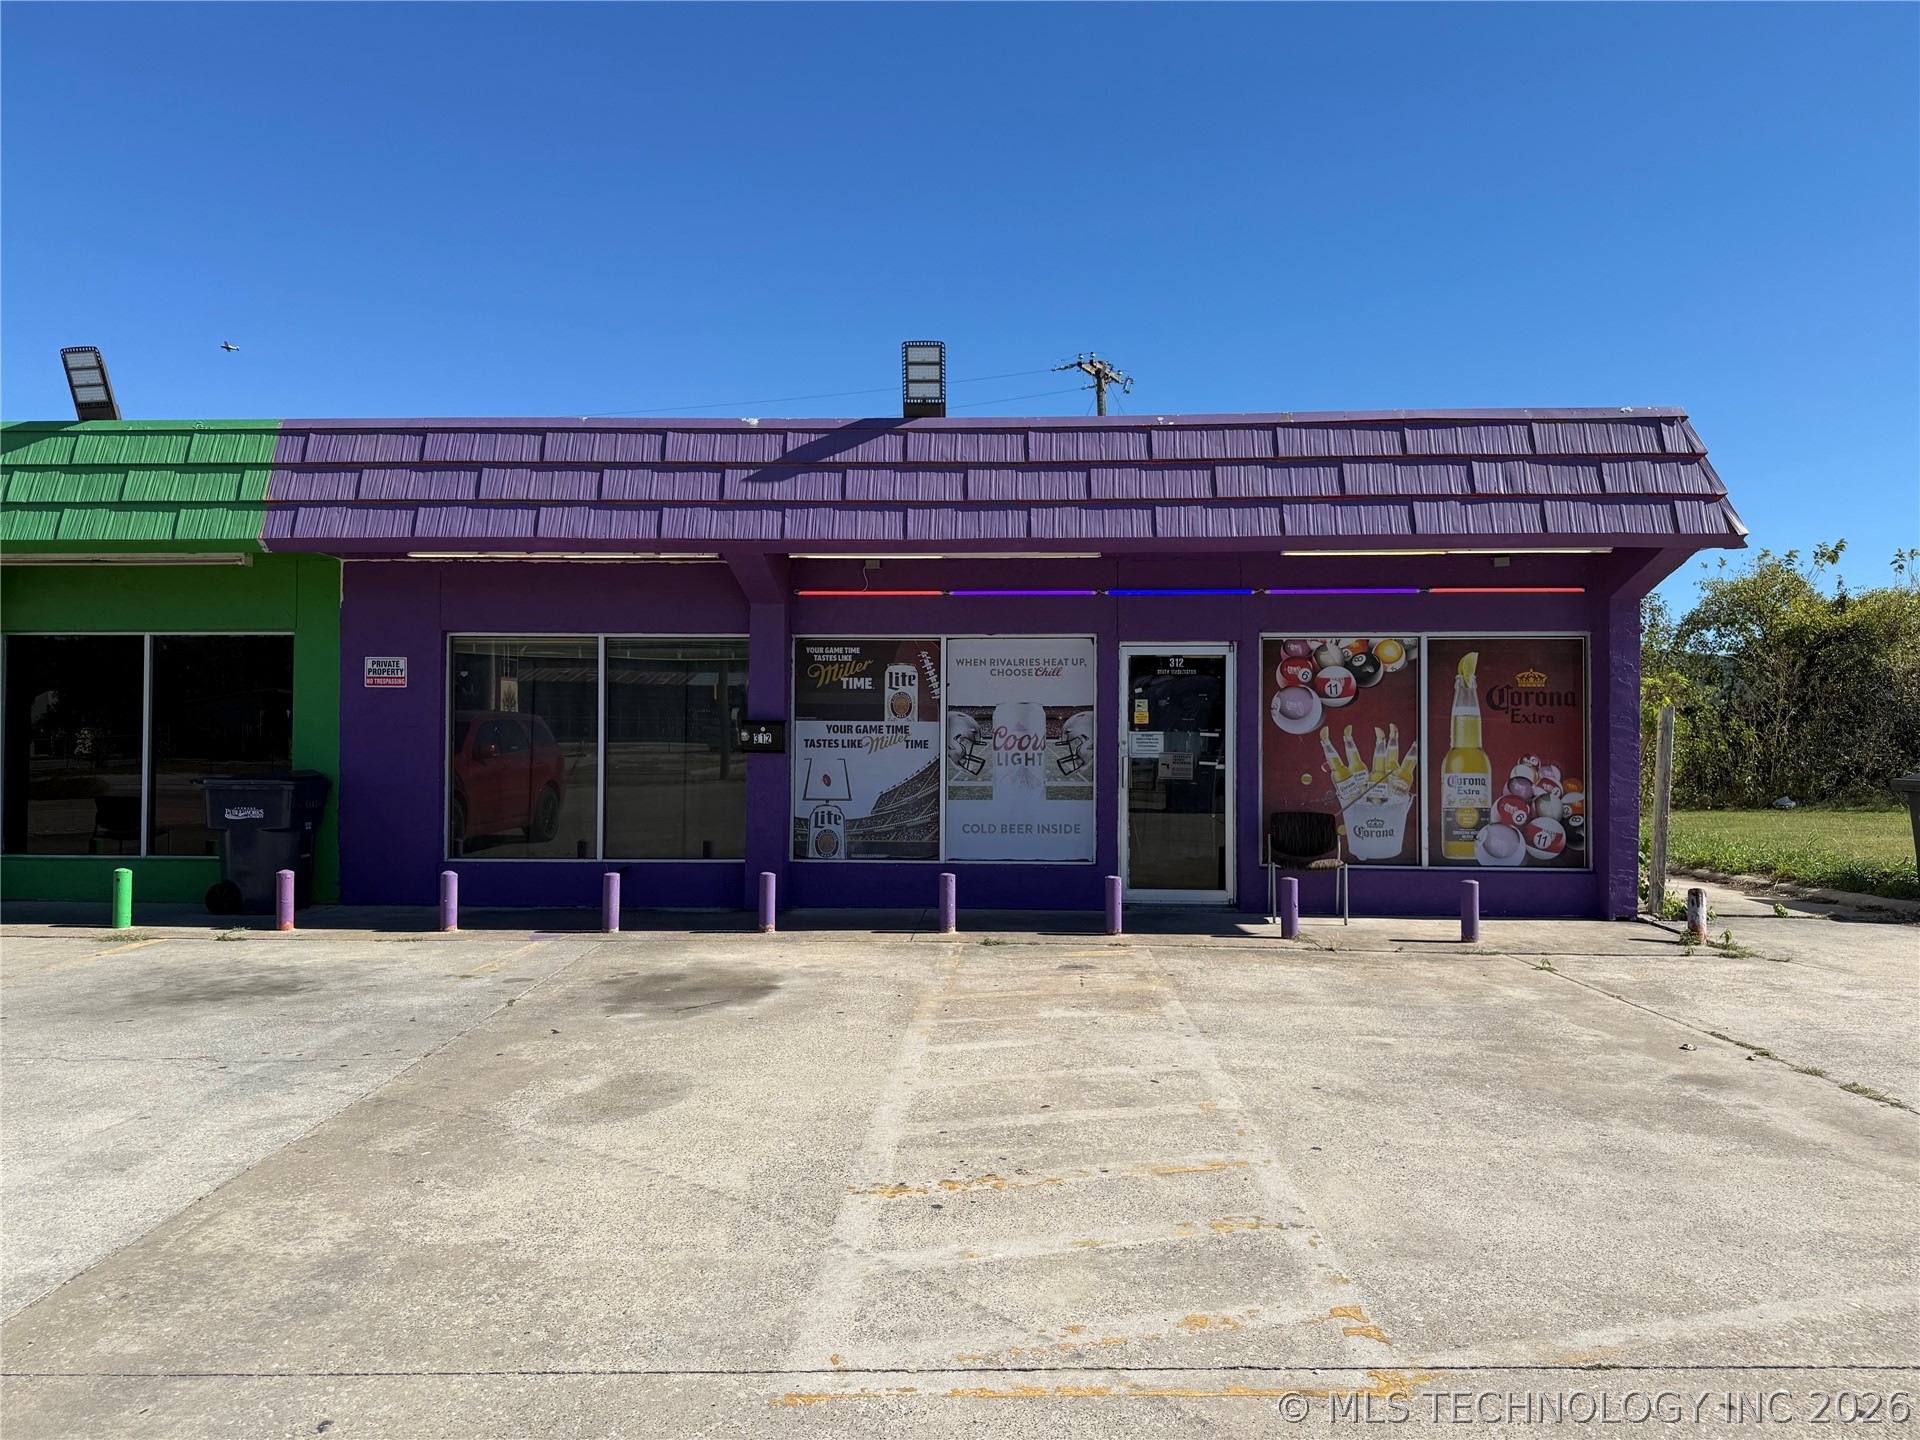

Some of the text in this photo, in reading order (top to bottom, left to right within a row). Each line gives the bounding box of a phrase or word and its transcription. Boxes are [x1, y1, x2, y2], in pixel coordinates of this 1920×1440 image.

[956, 658, 1087, 668] WHEN RIVALRIES HEAT UP,
[1170, 658, 1184, 668] 312
[808, 660, 874, 688] Miller
[990, 667, 1062, 677] CHOOSE Chill
[1302, 672, 1310, 680] 6
[888, 672, 916, 691] Lite
[1327, 684, 1338, 695] 11
[1486, 684, 1576, 714] Corona
[1510, 708, 1555, 724] Extra
[826, 724, 910, 734] YOUR GAME TIME
[754, 734, 771, 744] 312
[804, 732, 929, 755] TASTES LIKE Miller TIME
[992, 726, 1046, 752] Coors
[996, 752, 1043, 766] LIGHT
[1448, 774, 1486, 789] Corona
[1458, 786, 1480, 795] Extra
[814, 810, 842, 828] Lite
[962, 824, 1081, 834] COLD BEER INSIDE
[1353, 824, 1394, 840] Corona
[1536, 834, 1548, 847] 11
